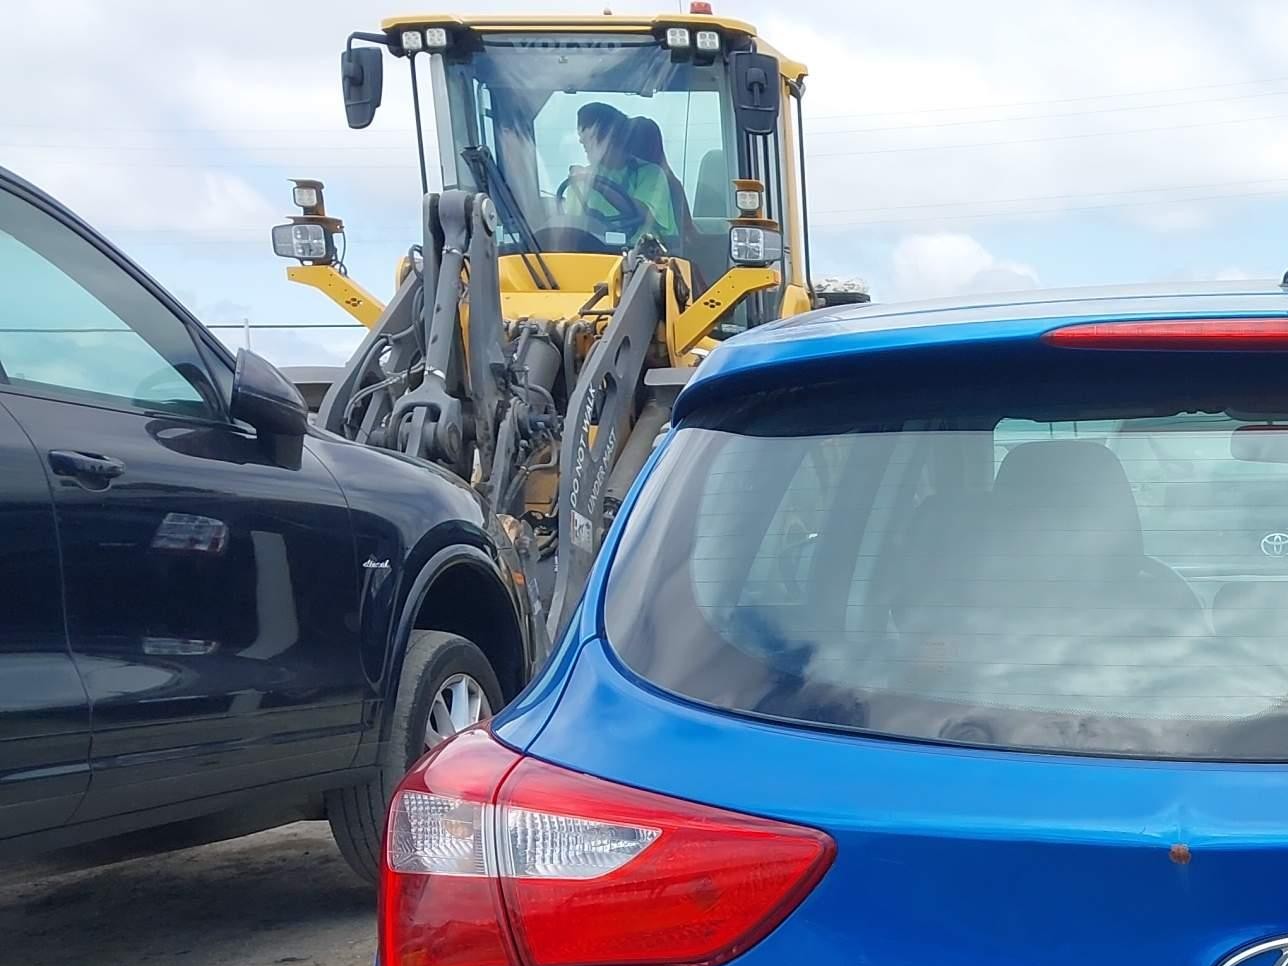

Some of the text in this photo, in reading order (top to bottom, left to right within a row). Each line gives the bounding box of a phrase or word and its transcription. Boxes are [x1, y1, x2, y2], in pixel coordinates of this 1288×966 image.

[511, 40, 622, 53] VOLVO
[570, 383, 596, 508] DO NOT WALK
[588, 426, 617, 515] UNDER MAST
